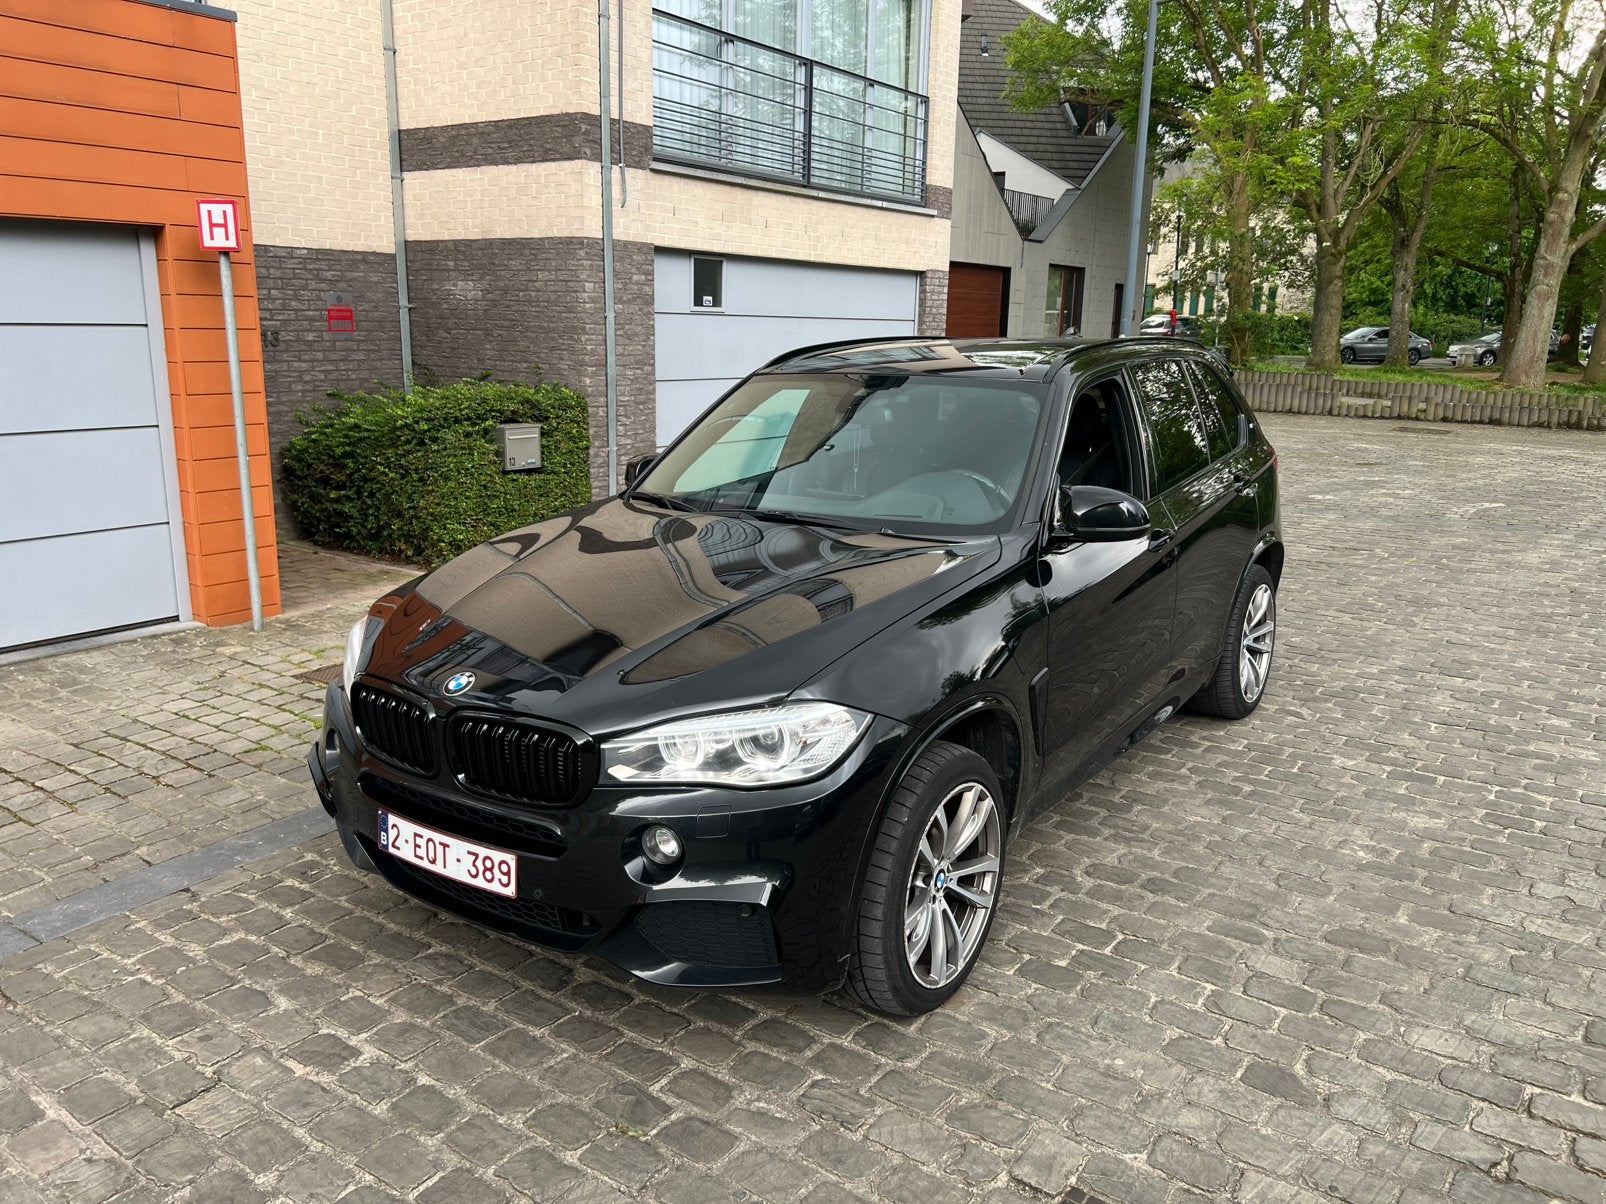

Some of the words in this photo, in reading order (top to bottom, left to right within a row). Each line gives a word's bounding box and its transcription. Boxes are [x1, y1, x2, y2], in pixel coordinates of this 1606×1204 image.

[207, 209, 229, 241] H
[509, 457, 516, 467] 13
[380, 831, 388, 845] B
[390, 822, 512, 889] 2-EQT-389
